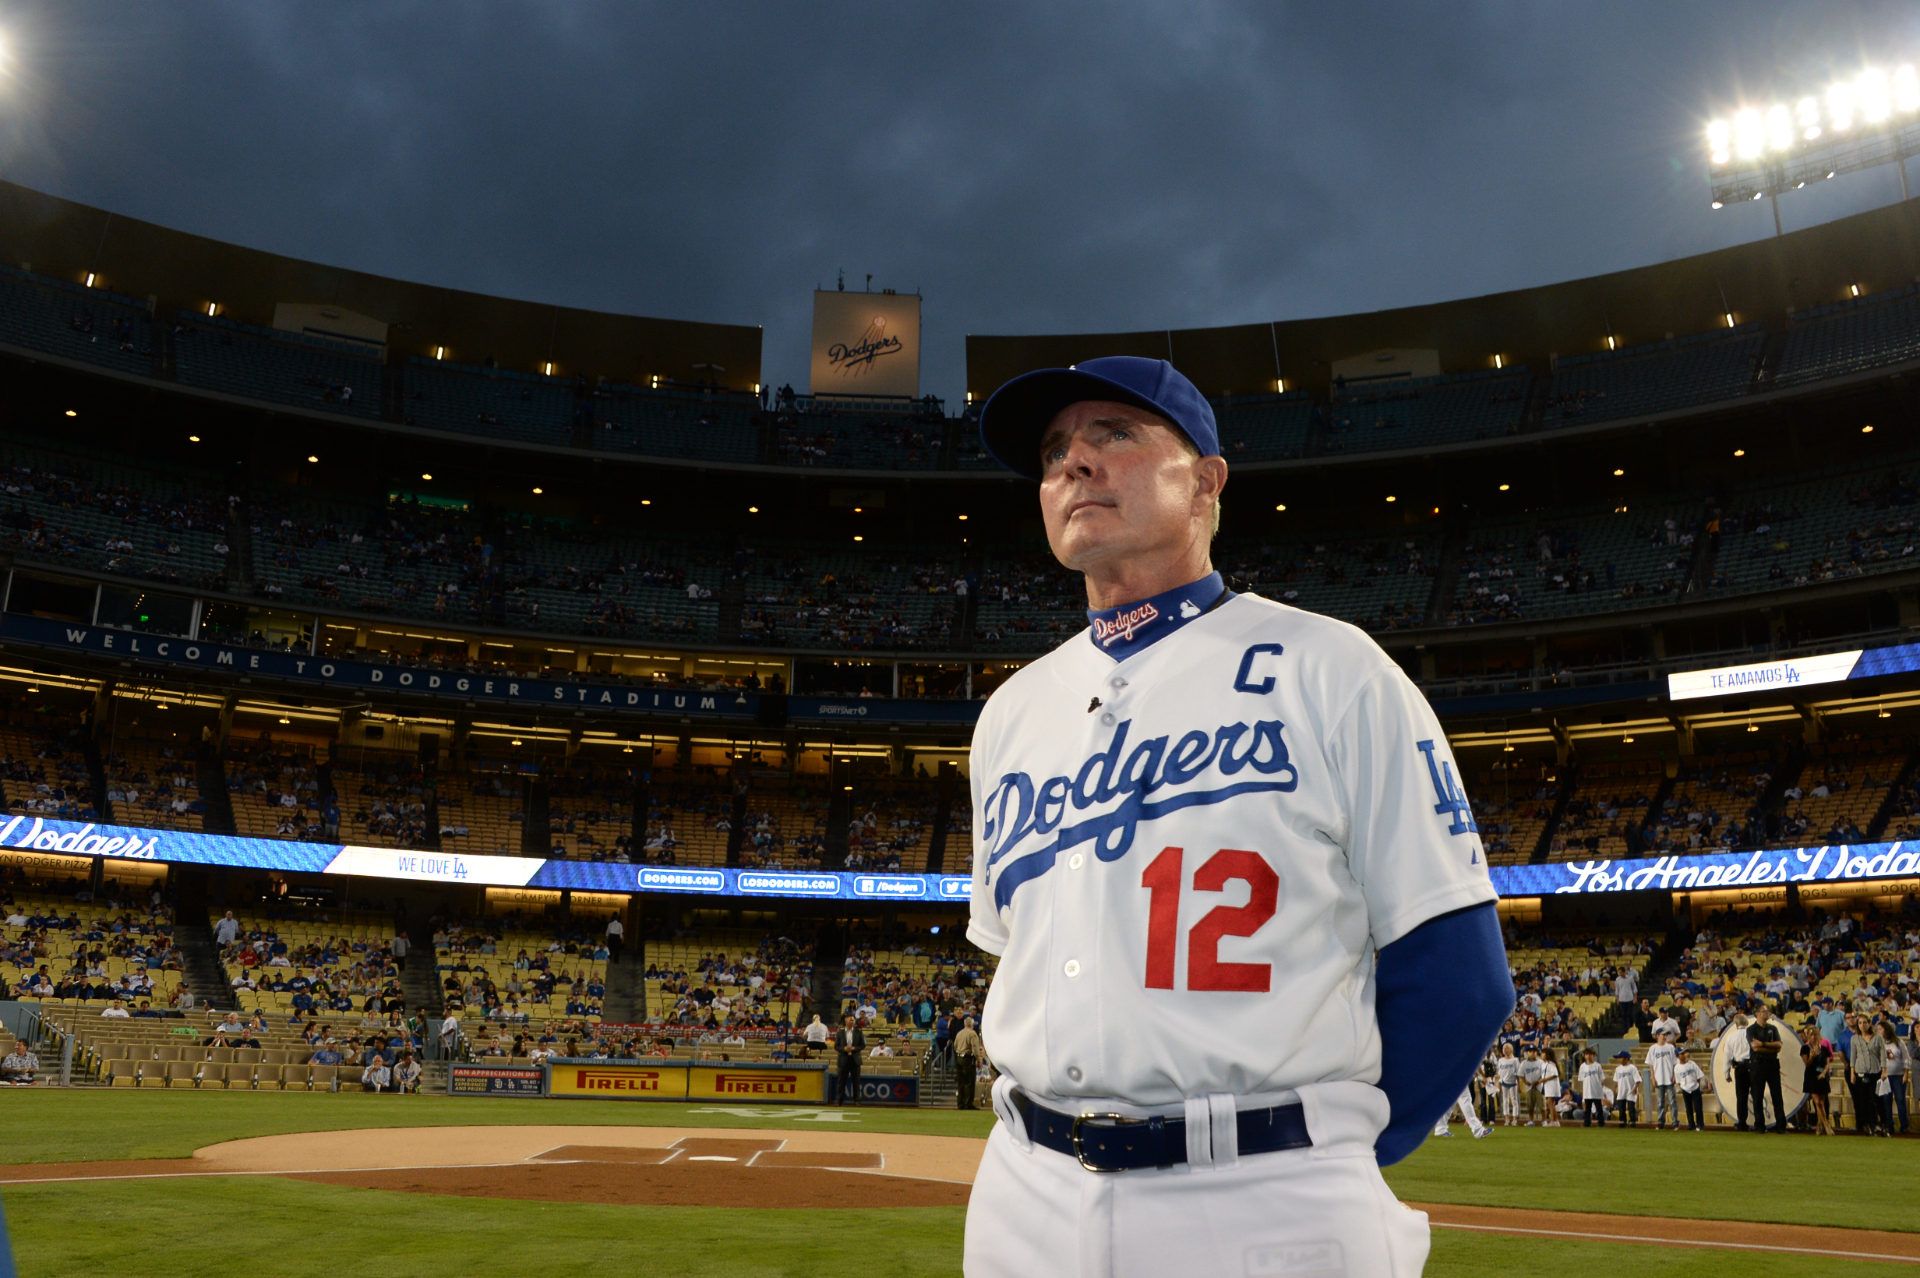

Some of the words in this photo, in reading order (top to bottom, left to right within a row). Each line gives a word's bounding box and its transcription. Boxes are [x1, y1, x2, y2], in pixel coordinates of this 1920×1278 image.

[829, 336, 902, 367] Dodgers
[1094, 602, 1158, 647] Dodgers
[66, 629, 259, 668] WELCOME
[296, 661, 335, 677] TO
[371, 669, 519, 696] DODGER
[554, 687, 715, 709] STADIUM
[1233, 643, 1284, 695] C
[1711, 675, 1724, 688] TE
[1728, 668, 1782, 687] AMAMOS
[1785, 663, 1800, 683] LA
[1416, 739, 1479, 836] LA
[983, 719, 1298, 912] Dodgers
[0, 816, 159, 859] Dodgers
[16, 855, 62, 867] DODGER
[65, 859, 92, 871] PIZZA
[399, 856, 417, 873] WE
[421, 859, 451, 874] LOVE
[453, 857, 468, 879] LA
[1555, 860, 1625, 894] Los
[1627, 850, 1788, 890] Angeles
[644, 873, 719, 886] DODGERS.COM
[743, 878, 836, 890] LOSDODGERS.COM
[1799, 888, 1828, 898] OGS
[514, 893, 557, 903] CAMPY'S
[1141, 846, 1279, 992] 12
[576, 1070, 659, 1091] PIRELLI
[716, 1074, 797, 1093] PIRELLI
